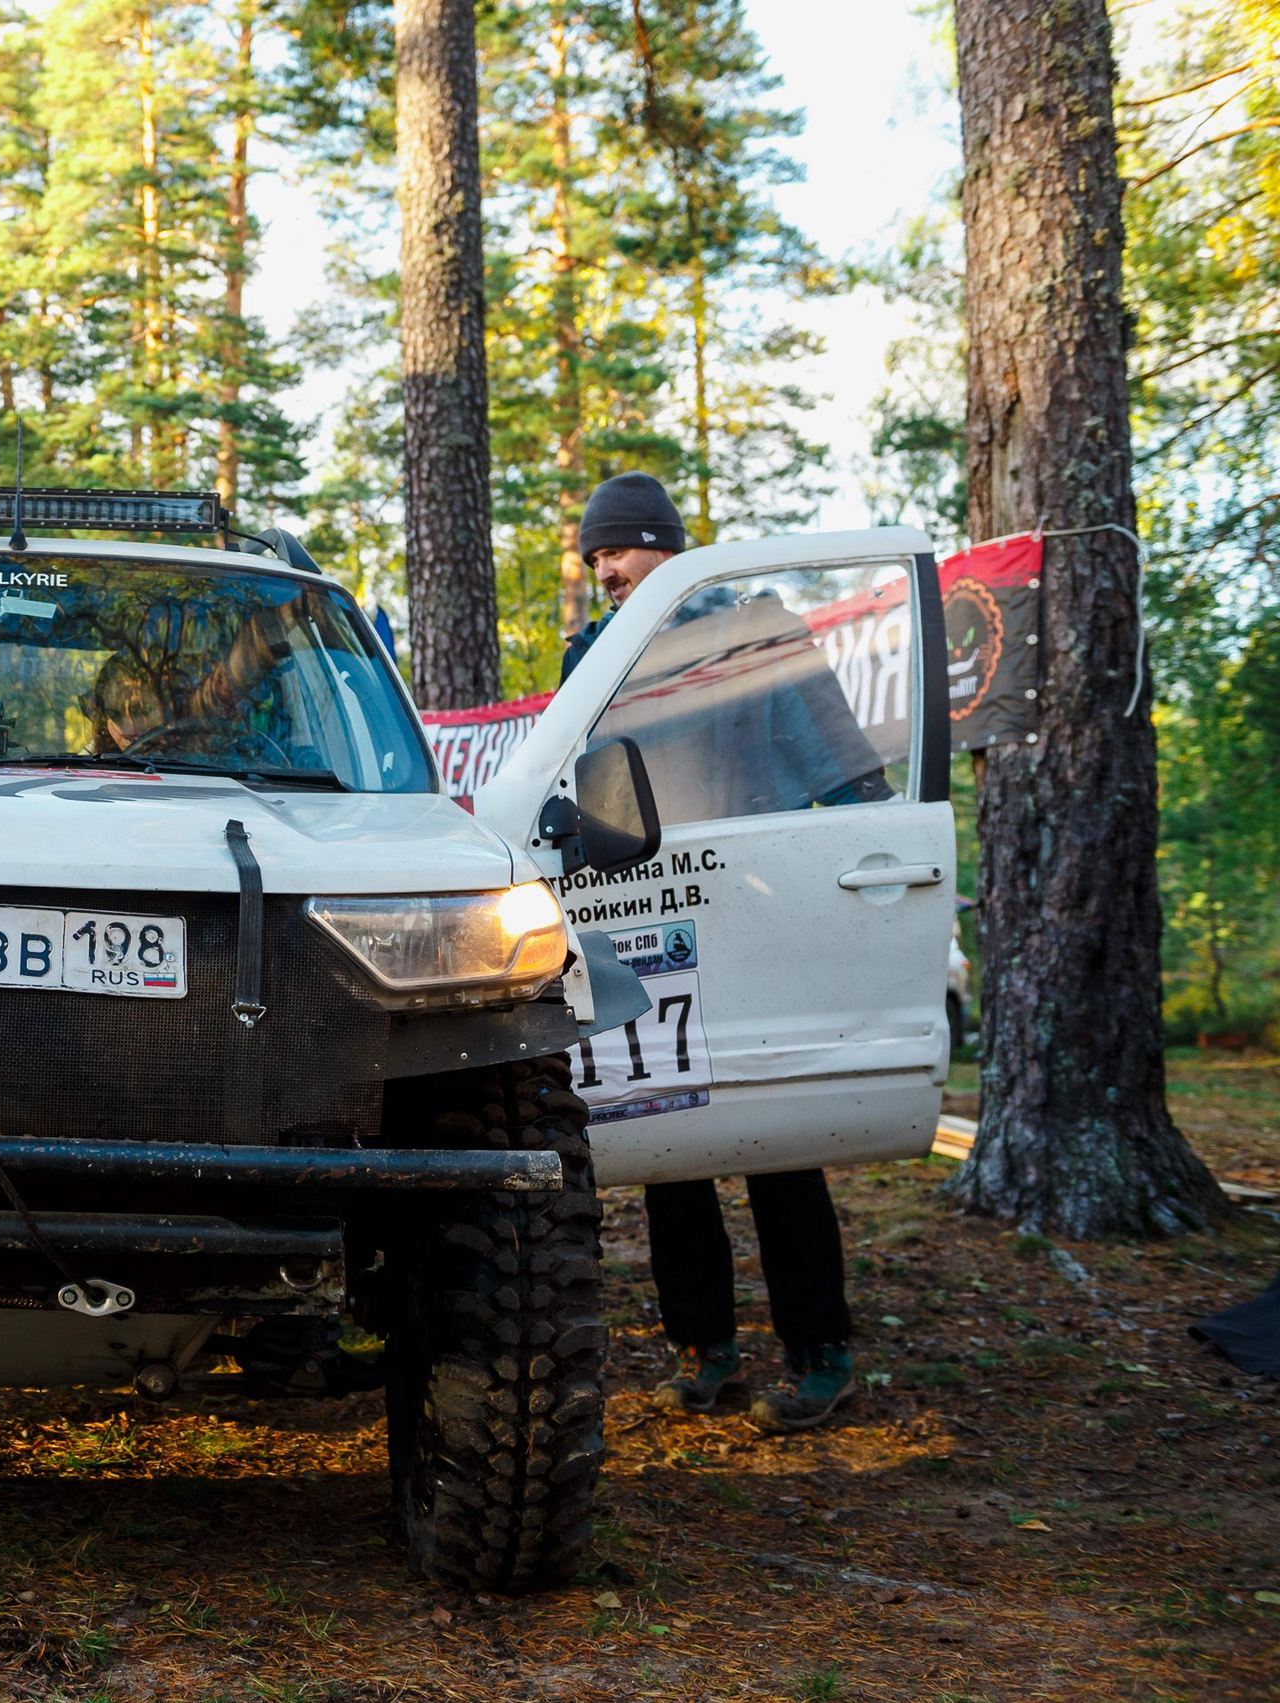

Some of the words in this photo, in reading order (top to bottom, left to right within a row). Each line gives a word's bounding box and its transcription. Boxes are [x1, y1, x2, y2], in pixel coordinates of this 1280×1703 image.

[671, 849, 726, 876] М.С.
[660, 884, 710, 916] Д.В.
[71, 919, 165, 968] 198
[635, 933, 658, 950] СПб
[90, 968, 140, 987] RUS
